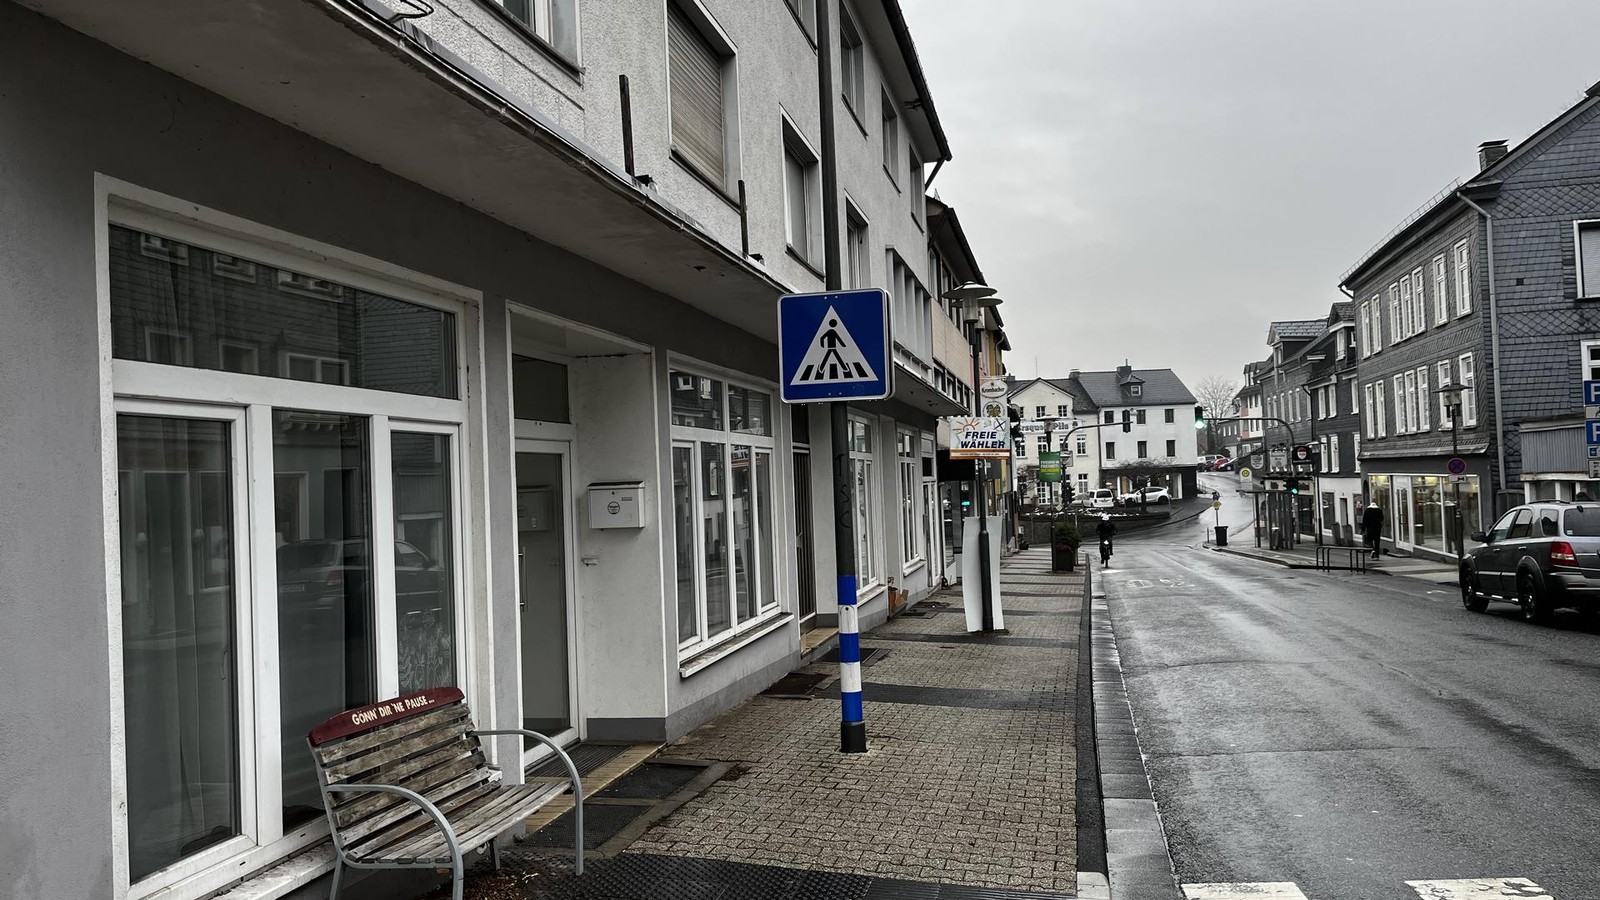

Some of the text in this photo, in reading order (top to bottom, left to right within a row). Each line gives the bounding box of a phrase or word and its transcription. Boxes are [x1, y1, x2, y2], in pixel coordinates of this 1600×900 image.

[964, 431, 998, 439] FREIE
[960, 439, 1006, 449] WÄHLER
[379, 706, 393, 717] DIR
